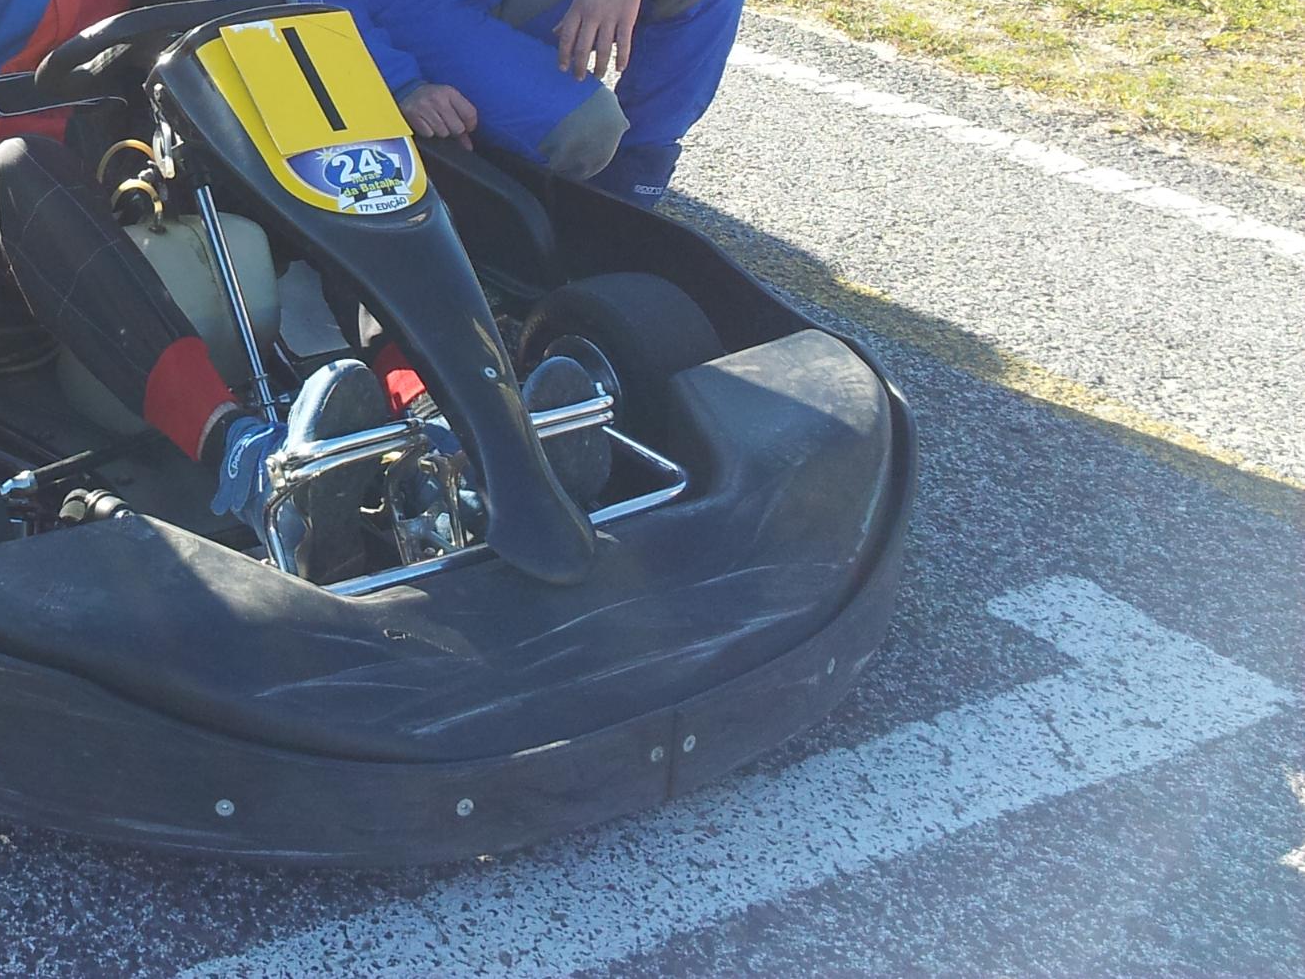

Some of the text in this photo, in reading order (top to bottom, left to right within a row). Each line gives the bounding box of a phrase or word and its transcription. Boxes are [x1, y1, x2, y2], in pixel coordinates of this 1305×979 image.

[281, 27, 347, 131] 1
[332, 150, 383, 184] 24
[344, 178, 403, 197] da Batalha
[376, 197, 408, 211] EDIÇÃO
